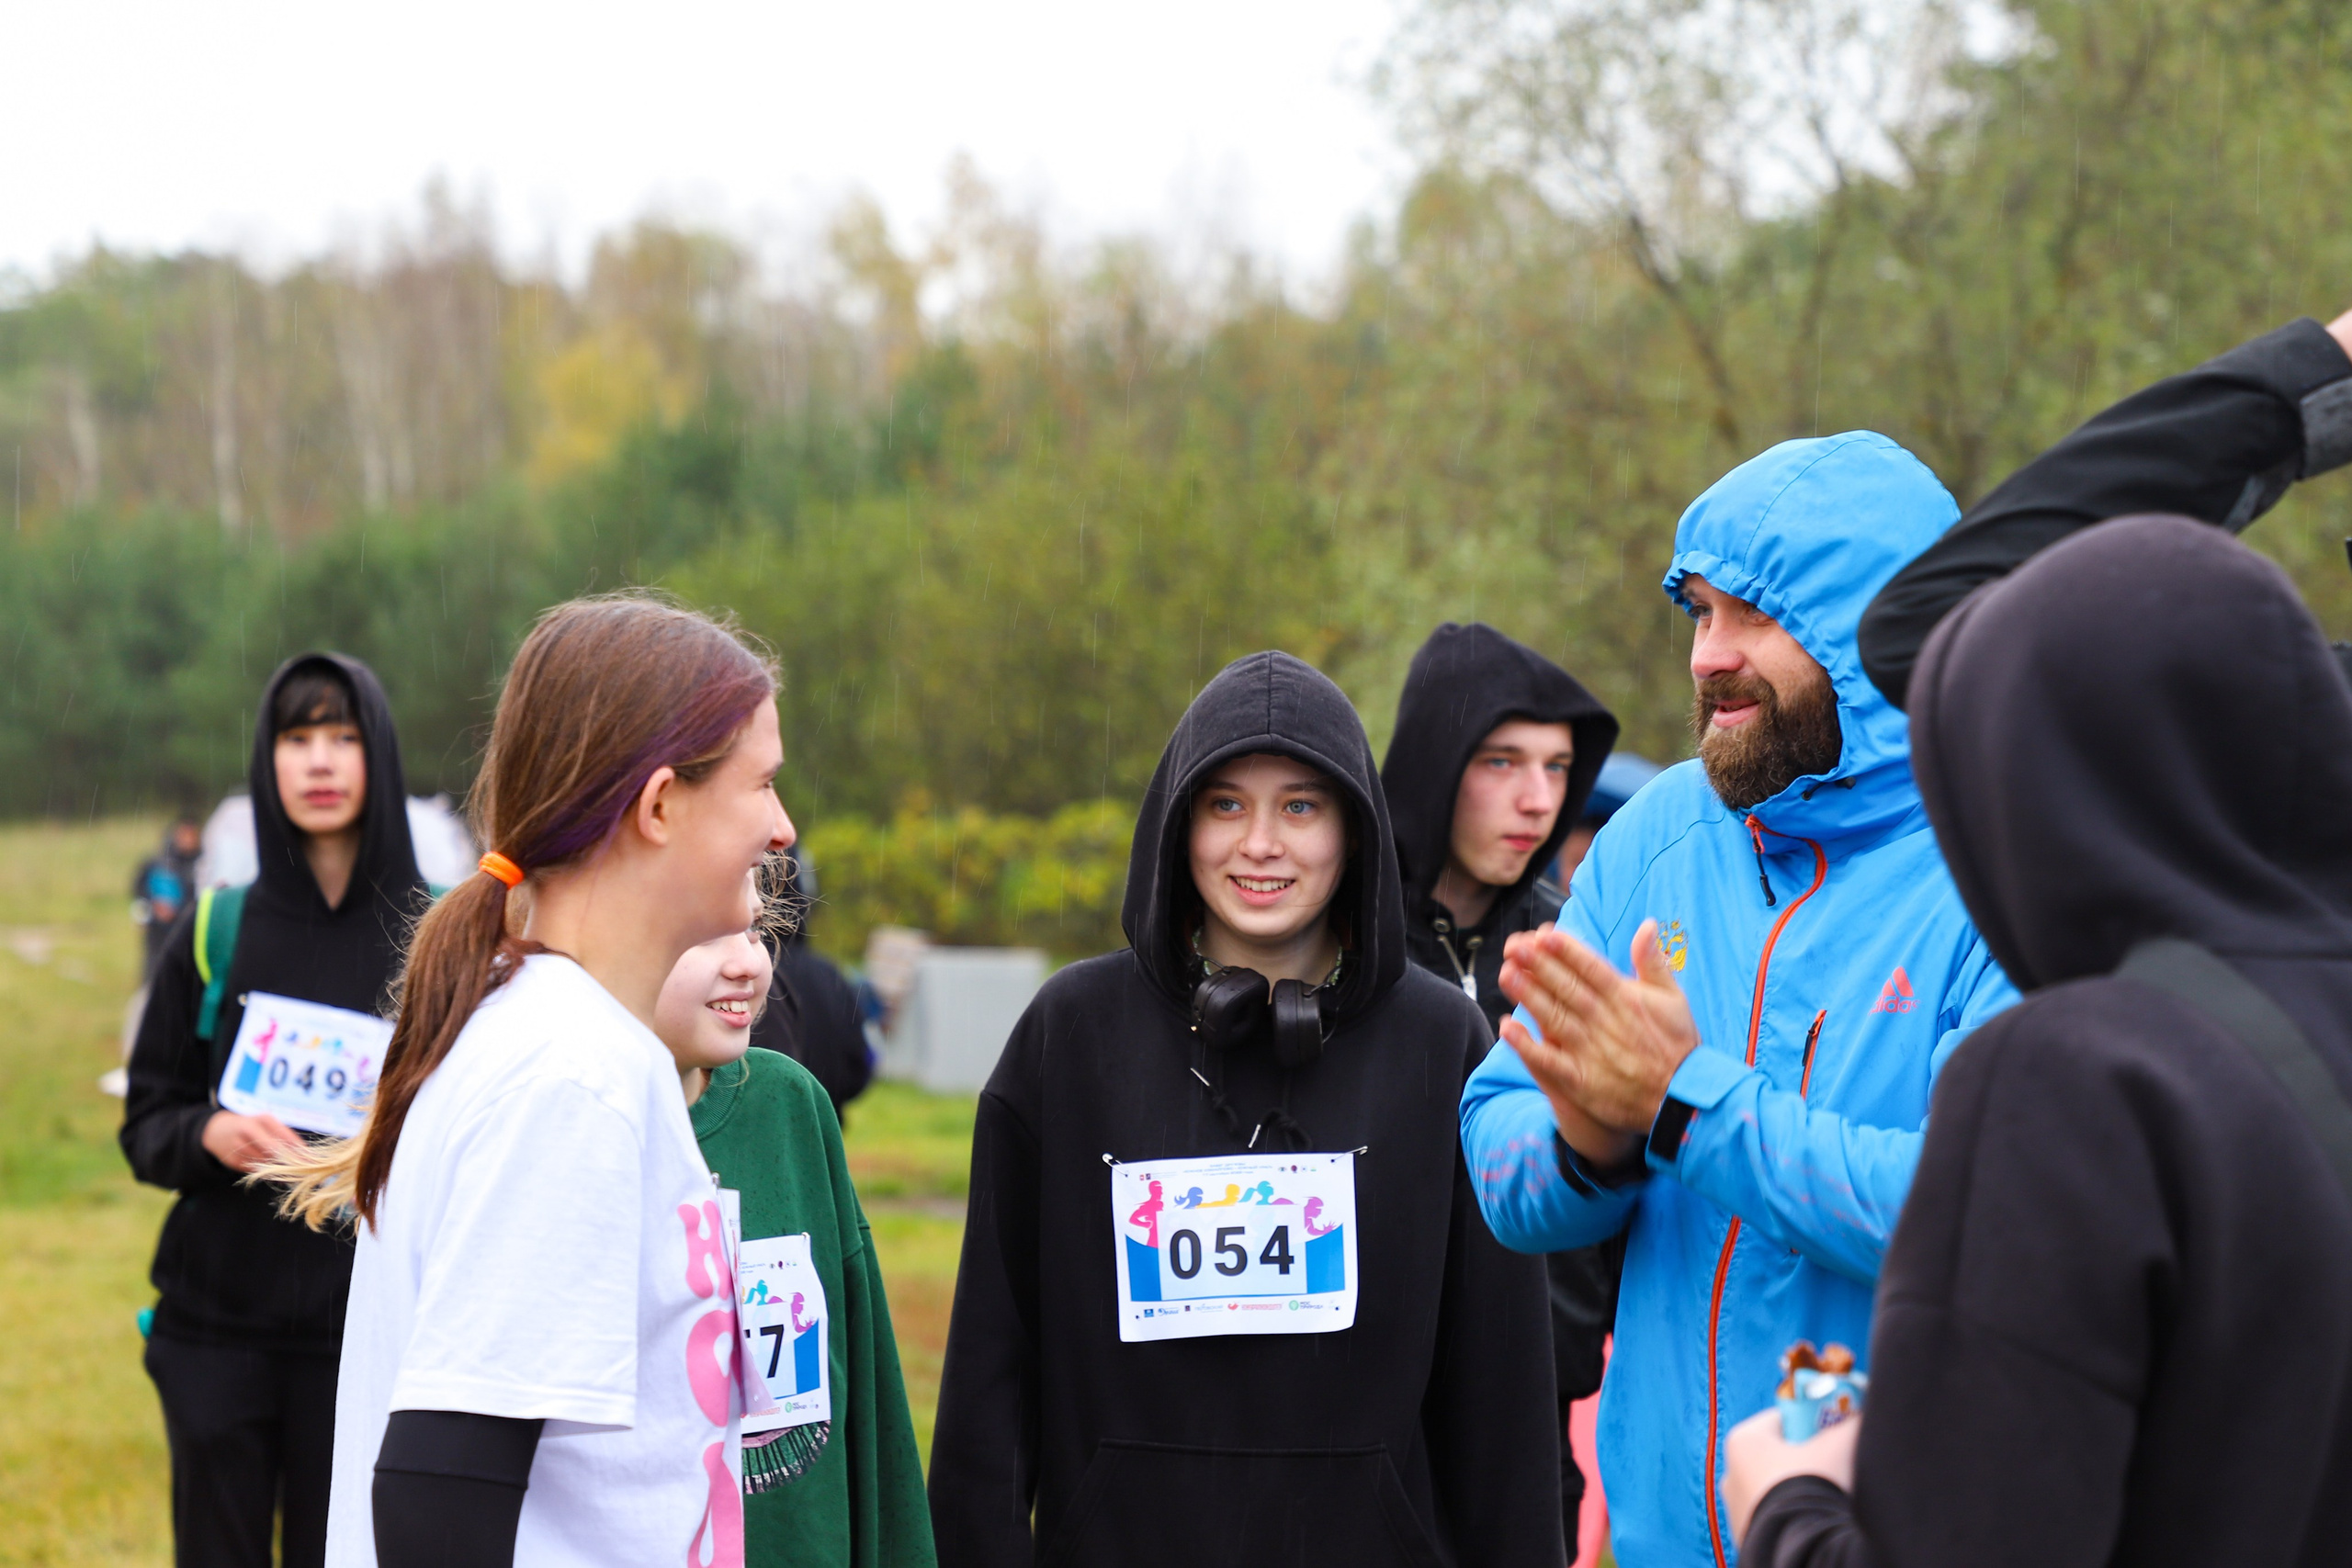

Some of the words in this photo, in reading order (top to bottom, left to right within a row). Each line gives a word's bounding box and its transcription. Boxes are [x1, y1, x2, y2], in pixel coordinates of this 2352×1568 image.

[268, 1056, 346, 1100] 049
[1170, 1224, 1295, 1280] 054
[743, 1324, 785, 1379] 7
